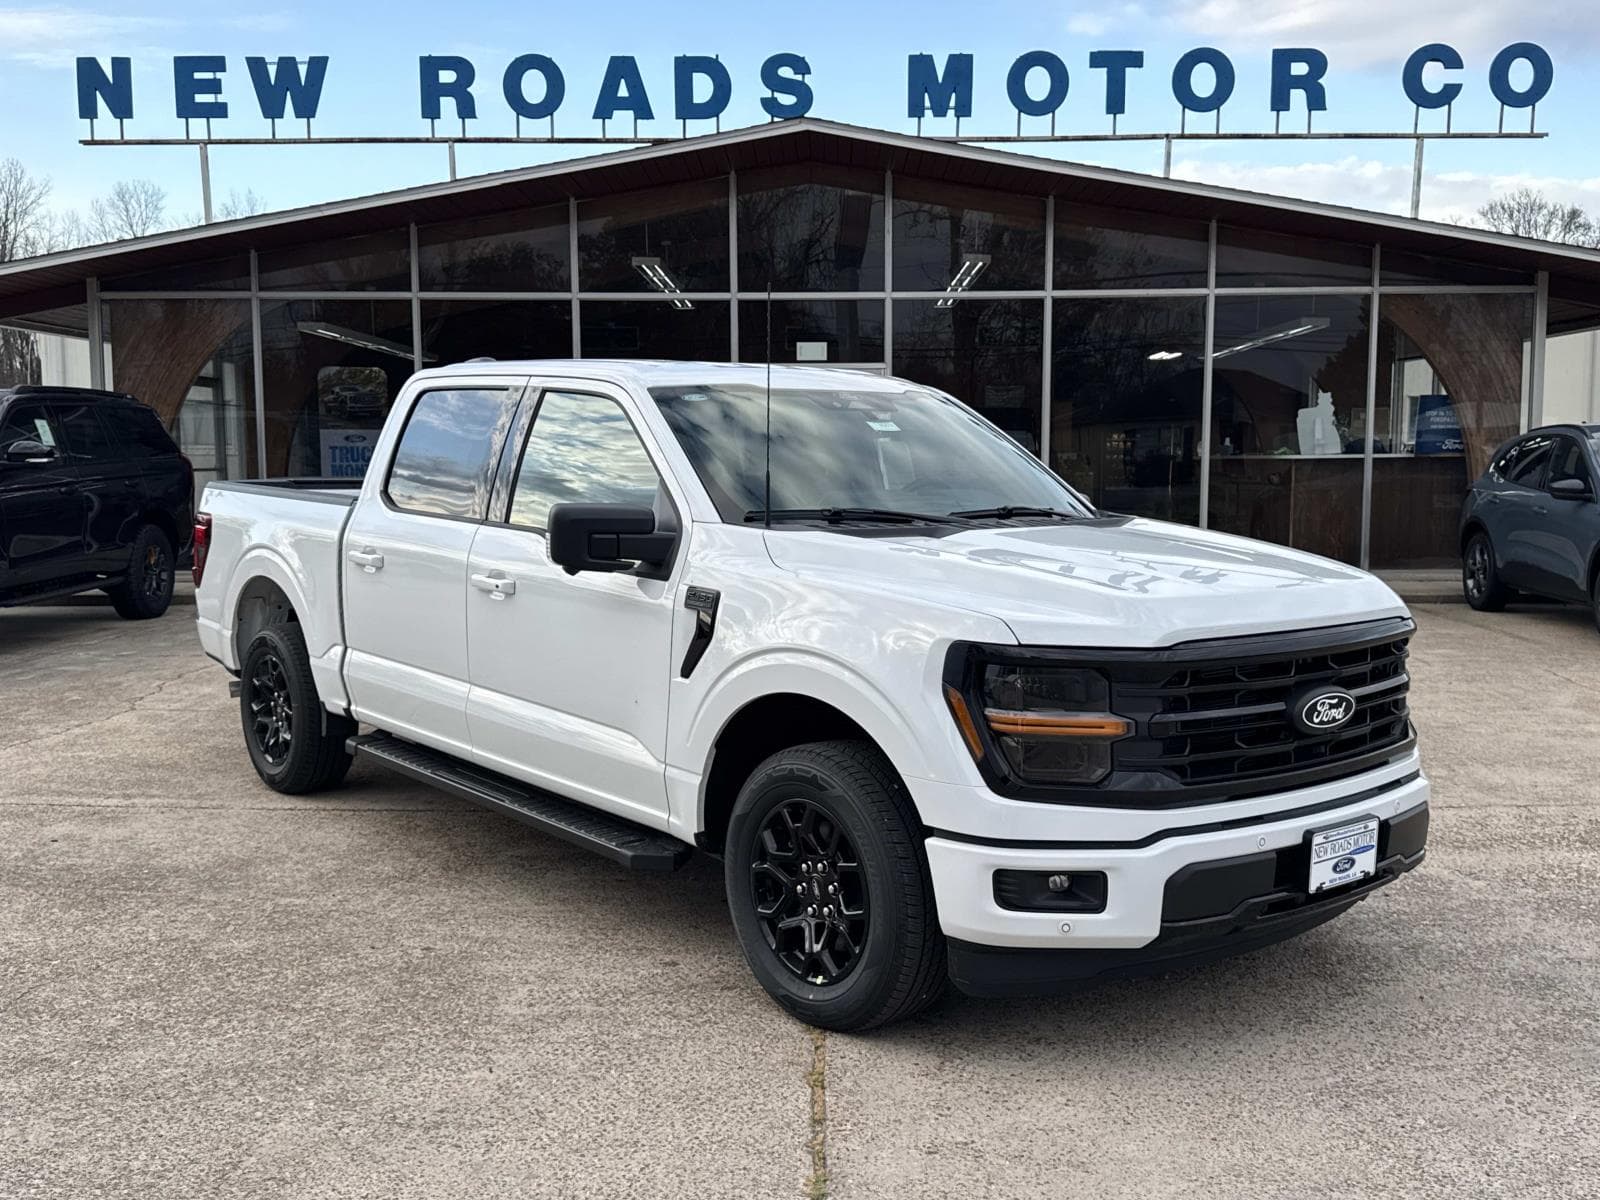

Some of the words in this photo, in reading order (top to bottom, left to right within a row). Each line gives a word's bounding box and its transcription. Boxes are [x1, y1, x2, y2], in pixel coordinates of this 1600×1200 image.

[76, 55, 329, 120] NEW
[419, 52, 814, 121] ROADS
[907, 46, 1329, 118] MOTOR
[1402, 42, 1554, 109] CO
[329, 446, 374, 463] TRUC
[331, 464, 370, 478] MON
[1312, 697, 1347, 724] Ford
[1315, 845, 1328, 861] NEW
[1330, 838, 1352, 856] ROADS
[1352, 832, 1375, 848] MOTOR
